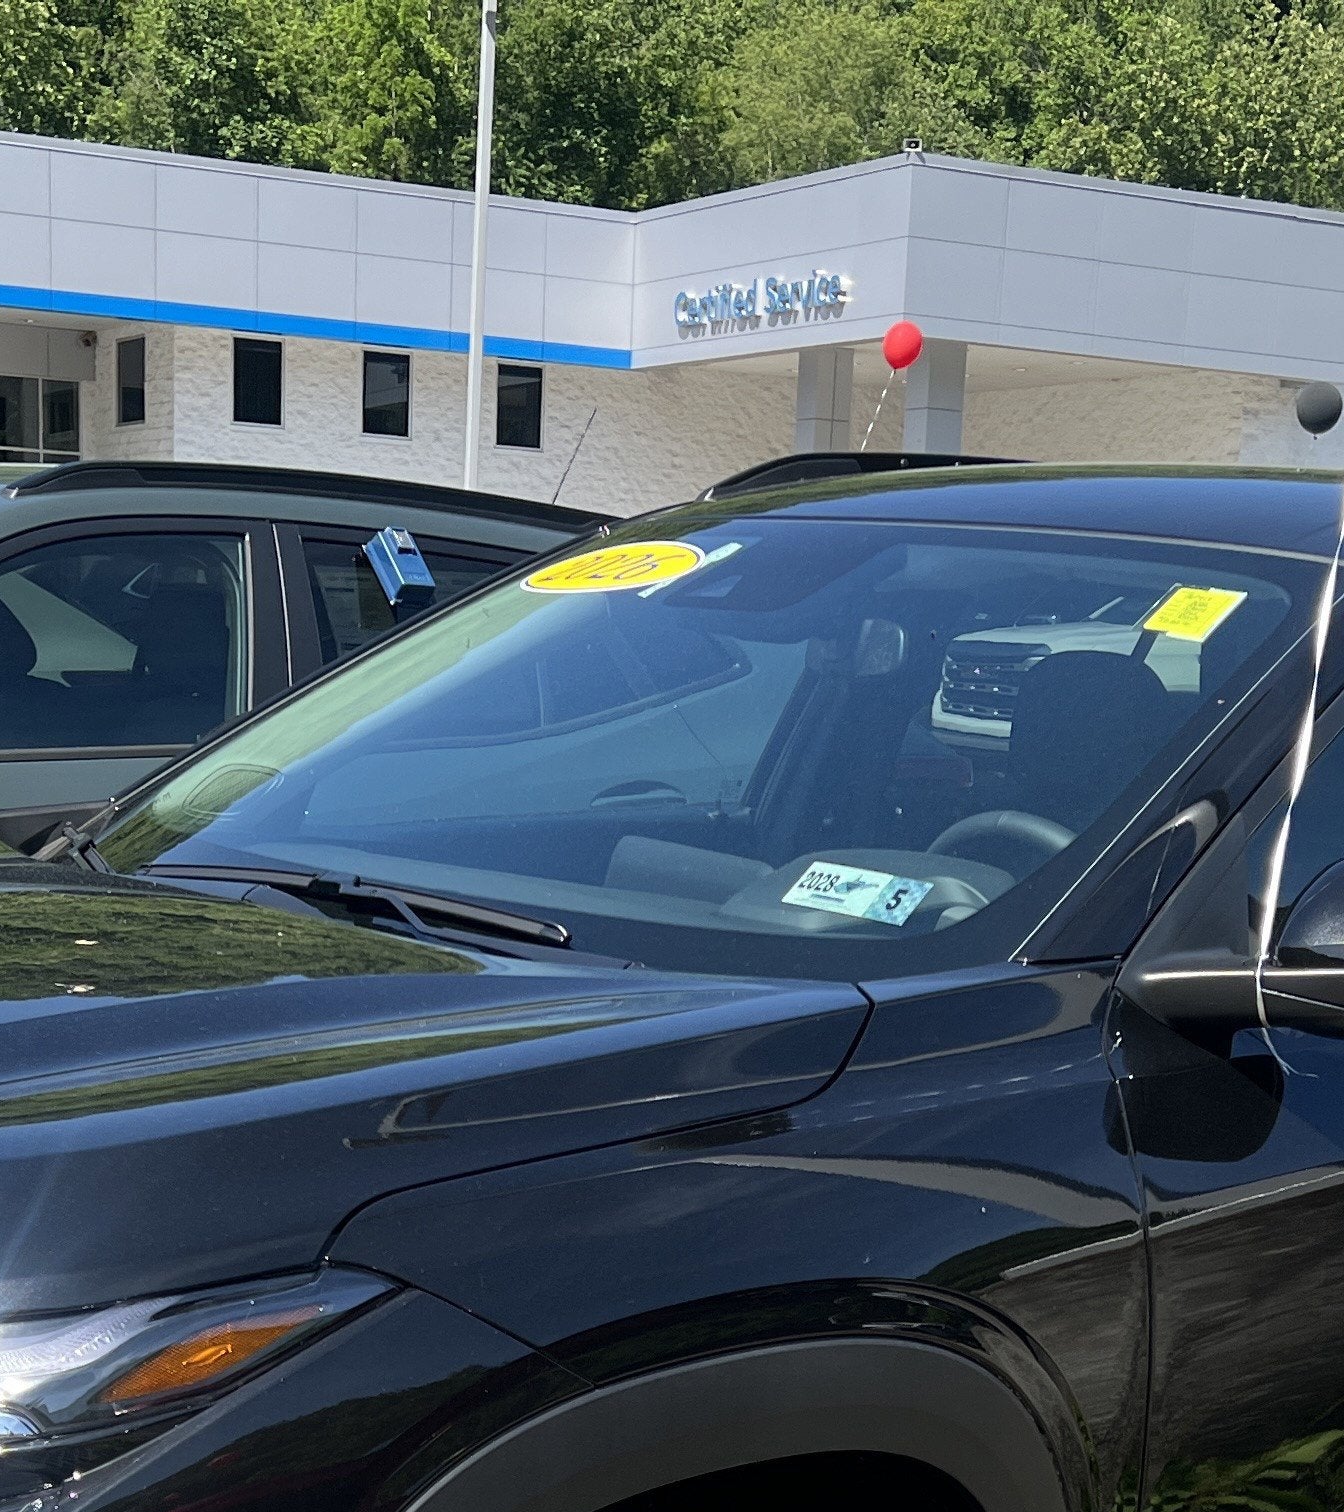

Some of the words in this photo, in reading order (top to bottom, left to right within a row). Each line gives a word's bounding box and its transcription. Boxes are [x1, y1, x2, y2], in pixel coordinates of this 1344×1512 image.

[674, 278, 761, 327] Certified
[764, 269, 850, 315] Service
[536, 552, 687, 581] 2026
[797, 870, 841, 893] 2028
[885, 888, 909, 911] 5
